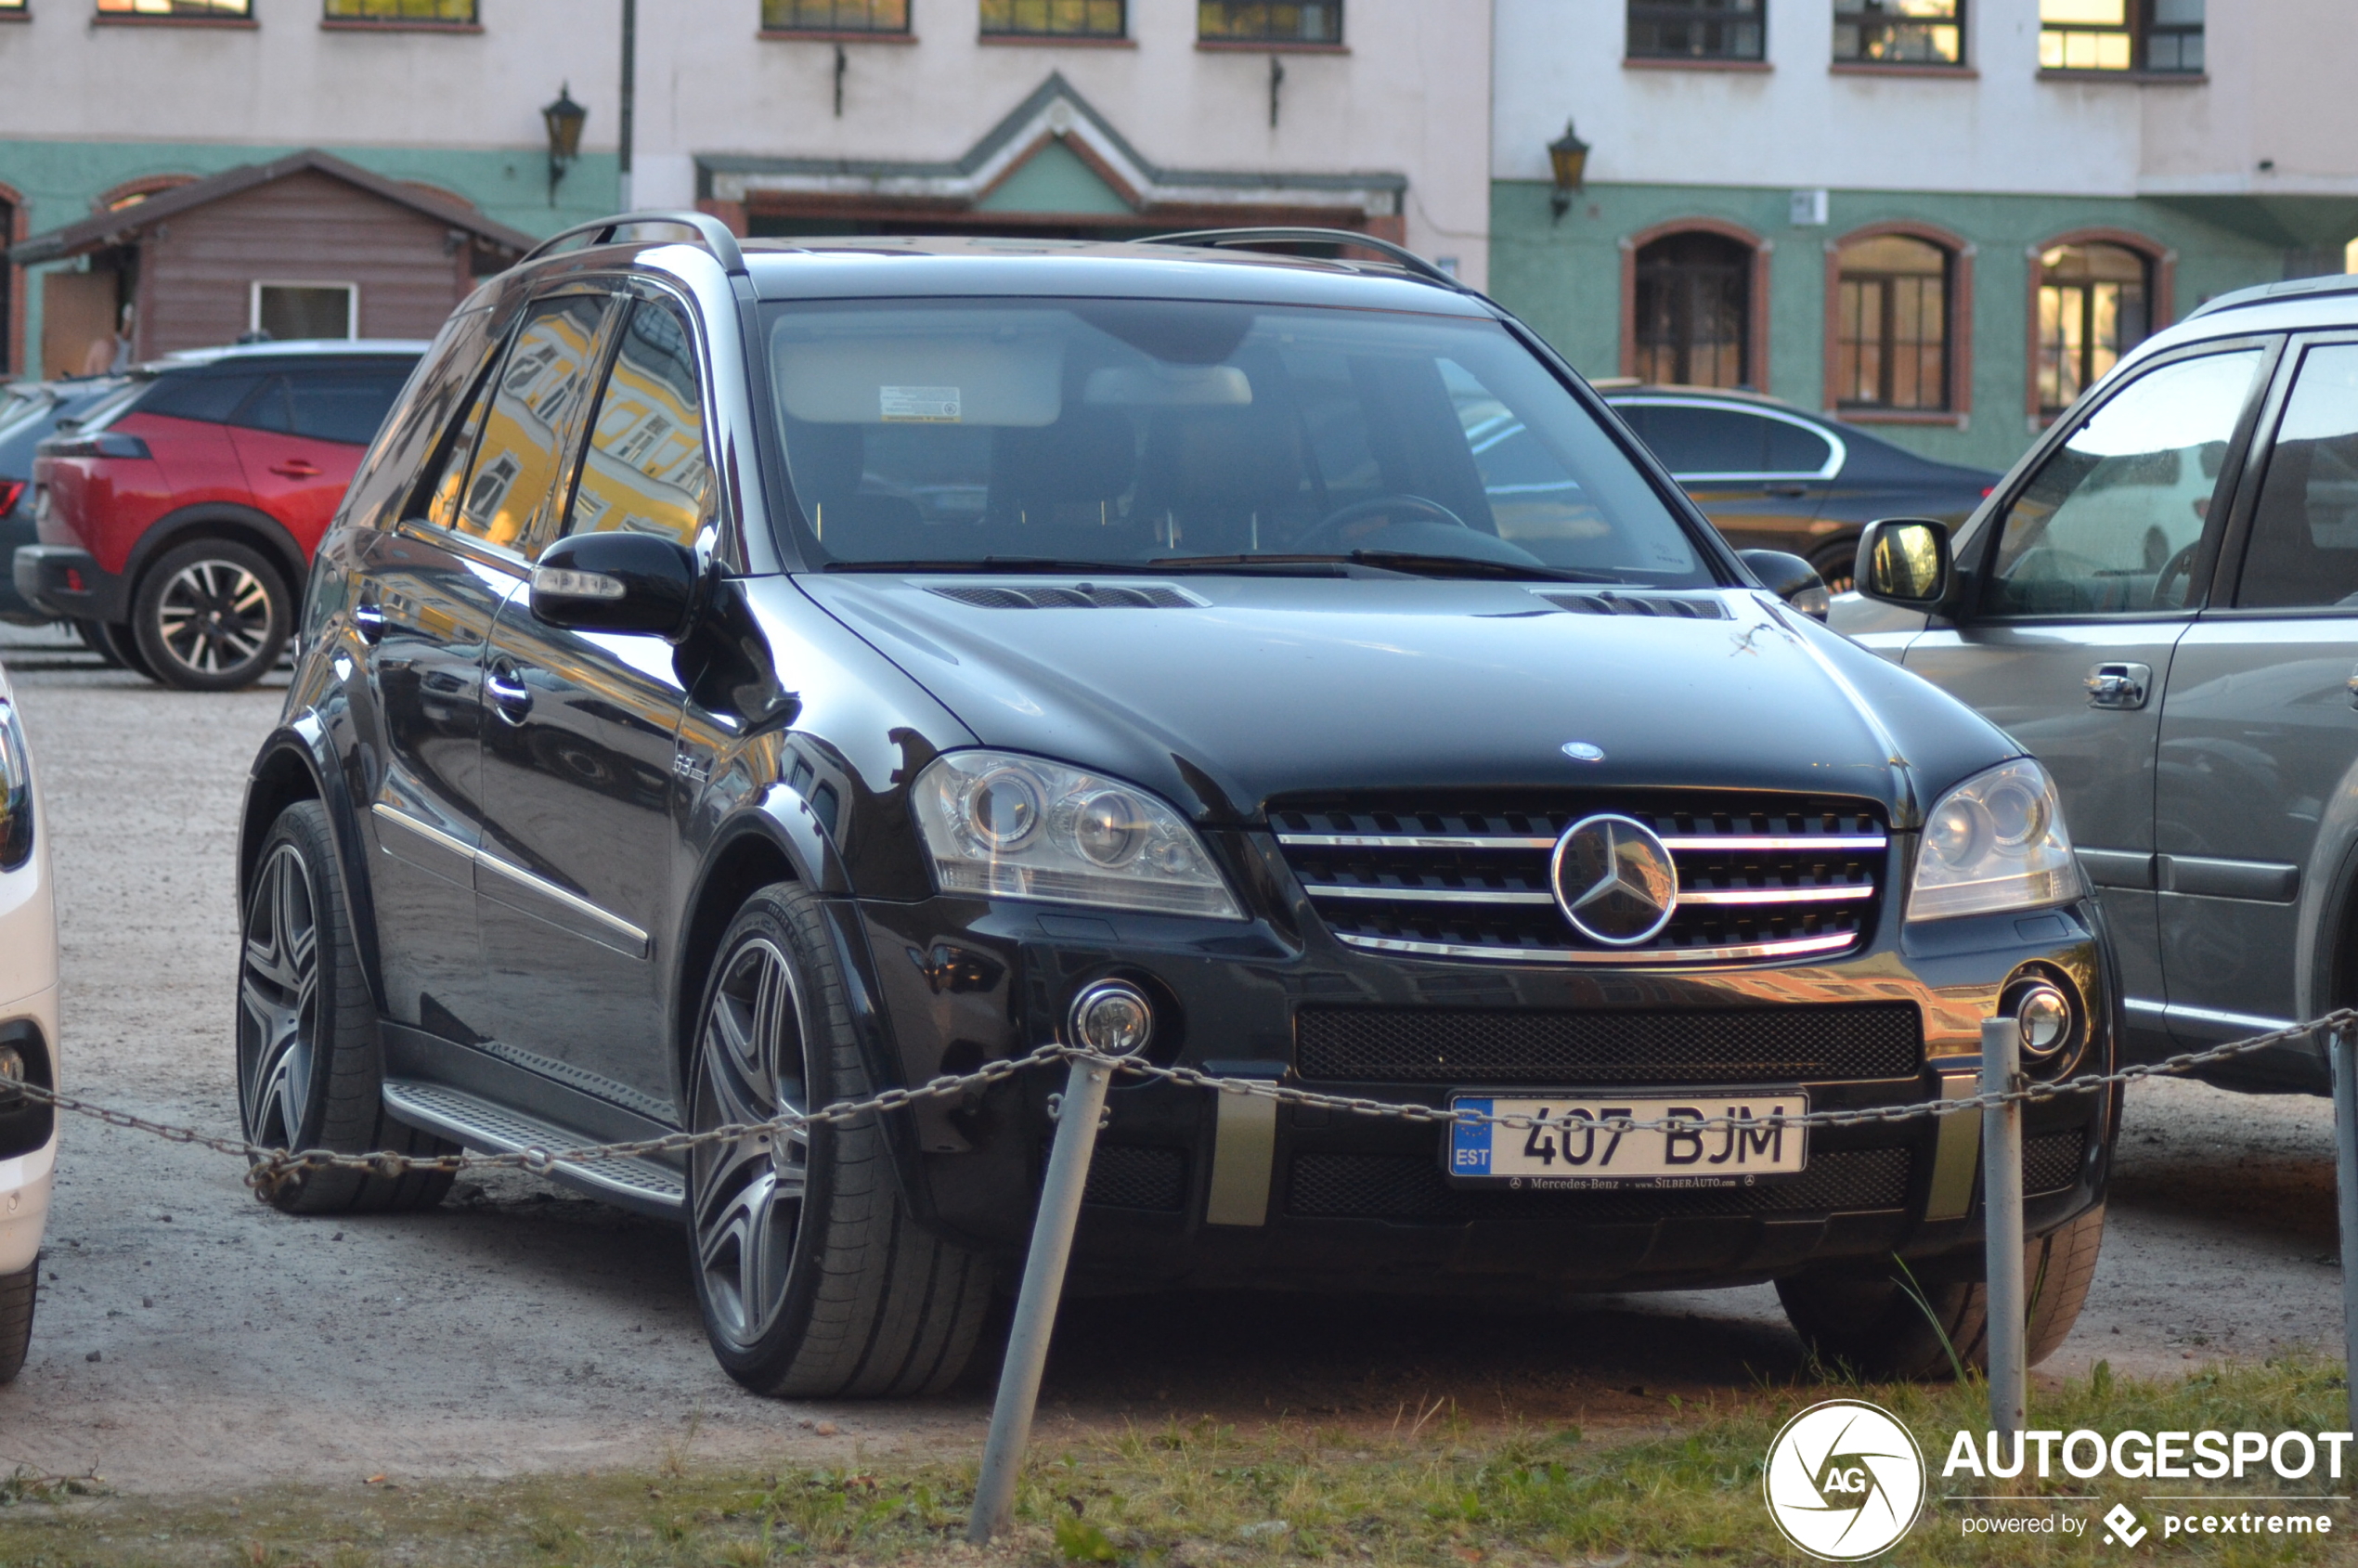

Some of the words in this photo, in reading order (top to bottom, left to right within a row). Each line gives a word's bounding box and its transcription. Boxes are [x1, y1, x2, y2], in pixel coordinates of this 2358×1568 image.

[1523, 1107, 1633, 1166] 407
[1665, 1104, 1784, 1165] BJM
[1456, 1148, 1489, 1166] EST
[1531, 1177, 1619, 1189] Mercedes-Benz
